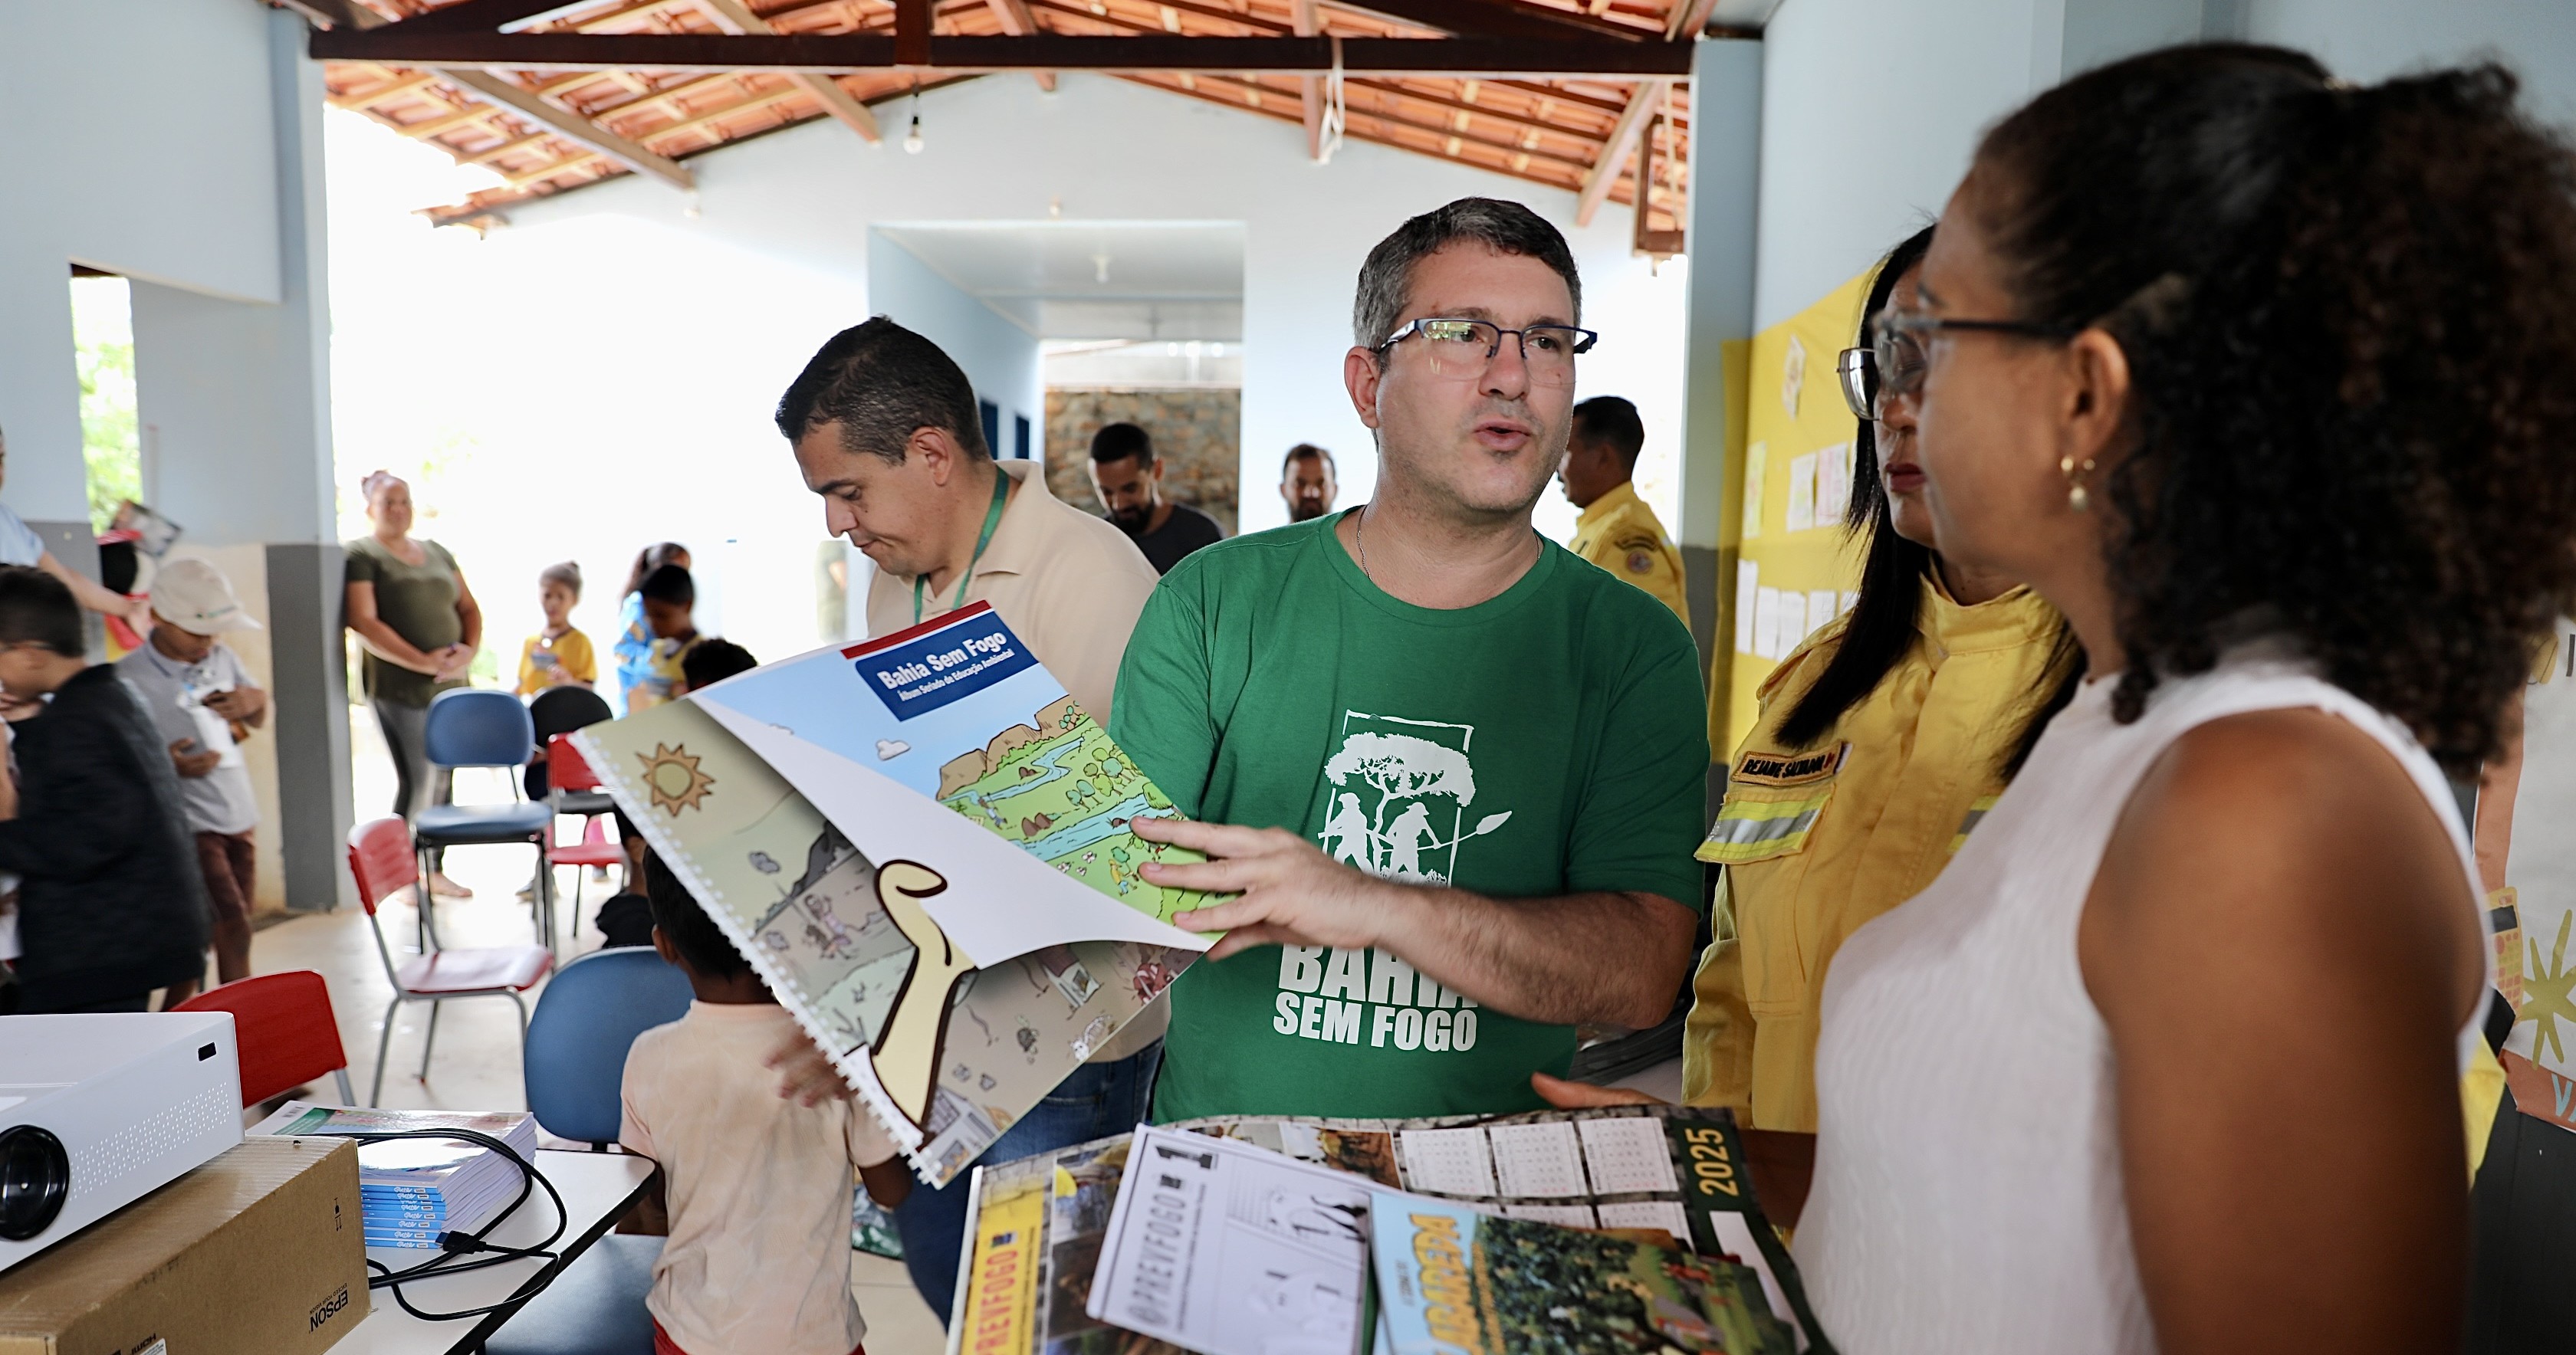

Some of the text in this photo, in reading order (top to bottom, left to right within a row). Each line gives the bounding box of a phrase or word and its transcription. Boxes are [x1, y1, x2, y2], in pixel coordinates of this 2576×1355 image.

[877, 632, 1007, 690] Bahia Sem Fogo
[920, 679, 946, 695] Seriado
[944, 674, 955, 686] de
[952, 662, 984, 683] Educação
[981, 648, 1016, 669] Ambiental
[1278, 942, 1478, 1009] BAHI
[1273, 991, 1477, 1052] SEM FOGO
[1155, 1145, 1214, 1170] 1
[1684, 1127, 1740, 1197] 2025
[310, 1288, 349, 1333] EPSON
[974, 1250, 1019, 1355] REVFOGO
